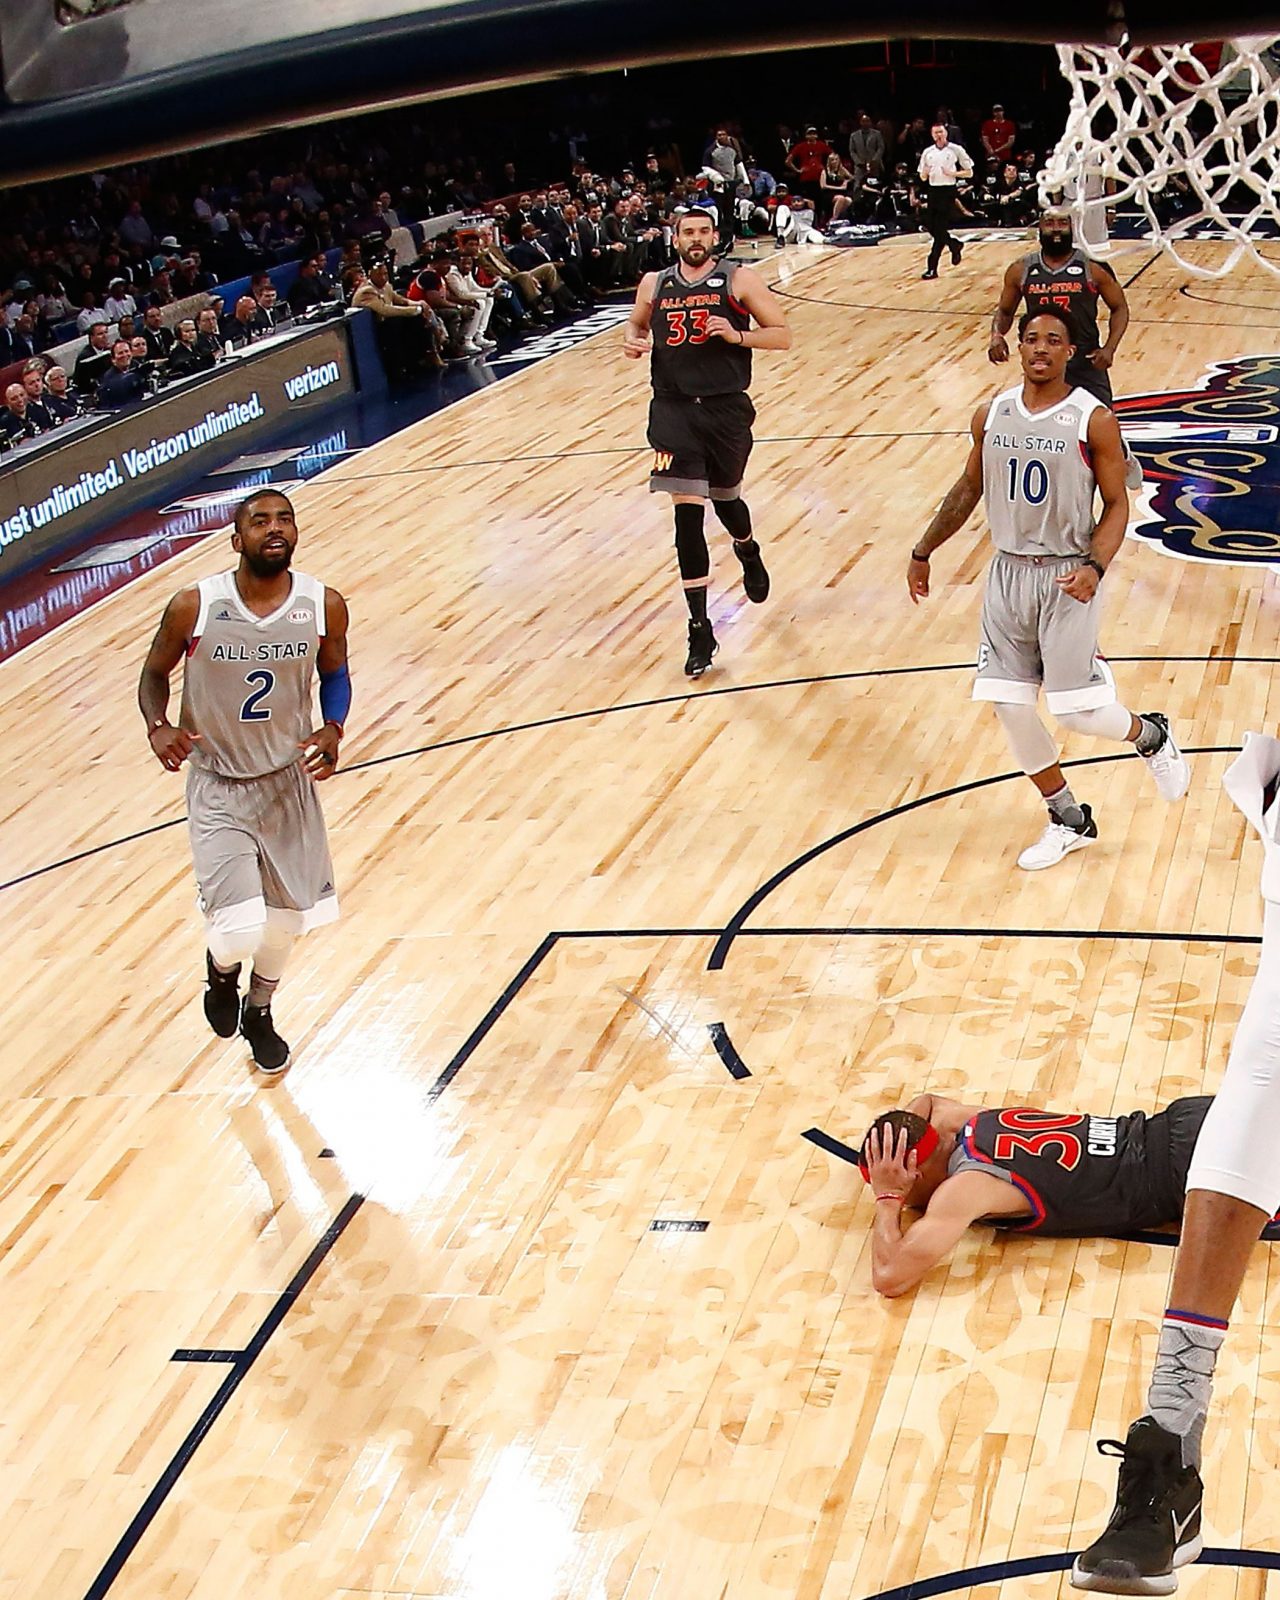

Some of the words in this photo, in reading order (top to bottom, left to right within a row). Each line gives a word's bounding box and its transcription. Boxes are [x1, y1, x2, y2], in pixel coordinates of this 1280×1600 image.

[666, 309, 709, 346] 33
[285, 361, 340, 400] verizon
[0, 507, 31, 549] ust
[32, 460, 124, 528] unlimited.
[123, 431, 188, 479] Verizon
[190, 393, 265, 449] unlimited.
[1008, 457, 1049, 505] 10
[239, 669, 275, 722] 2
[995, 1107, 1086, 1172] 30
